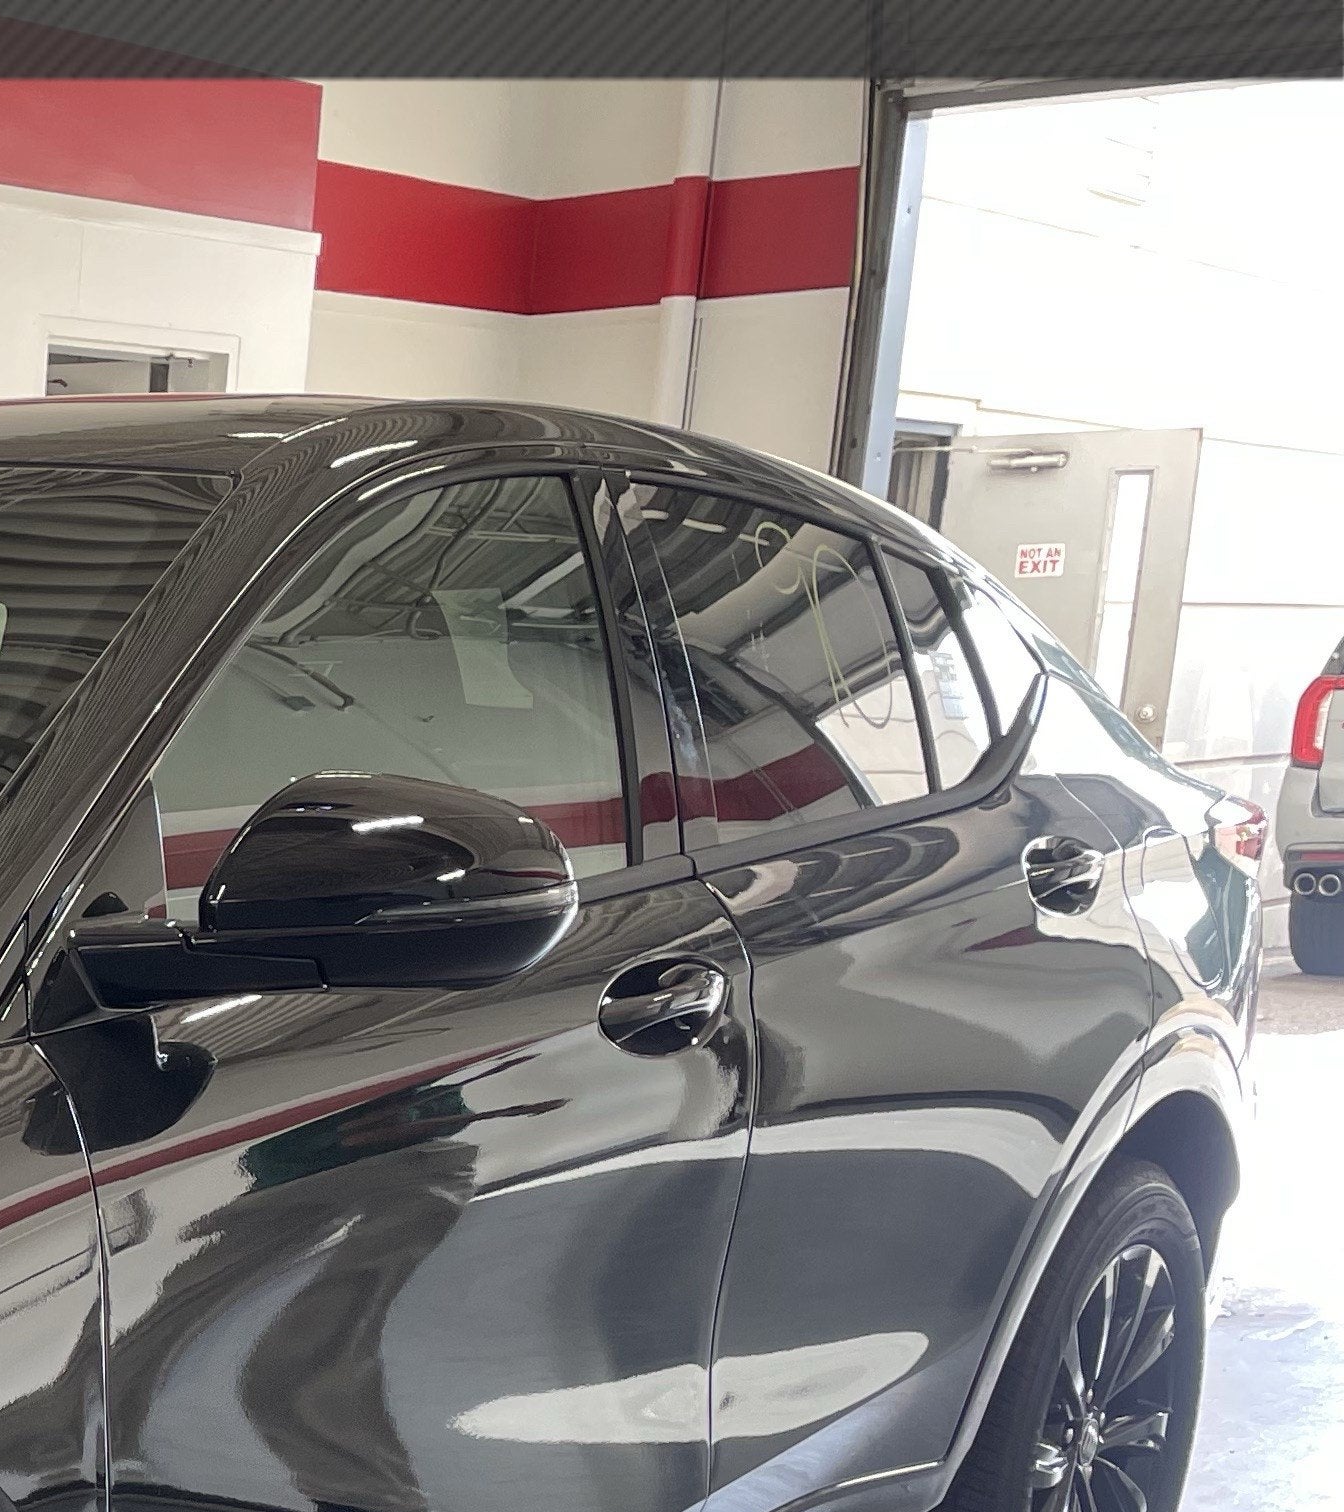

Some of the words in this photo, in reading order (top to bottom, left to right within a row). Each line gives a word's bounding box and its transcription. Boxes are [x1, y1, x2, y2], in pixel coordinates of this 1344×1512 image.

[1020, 547, 1043, 559] NOT
[1046, 547, 1062, 559] AN
[1018, 559, 1060, 575] EXIT
